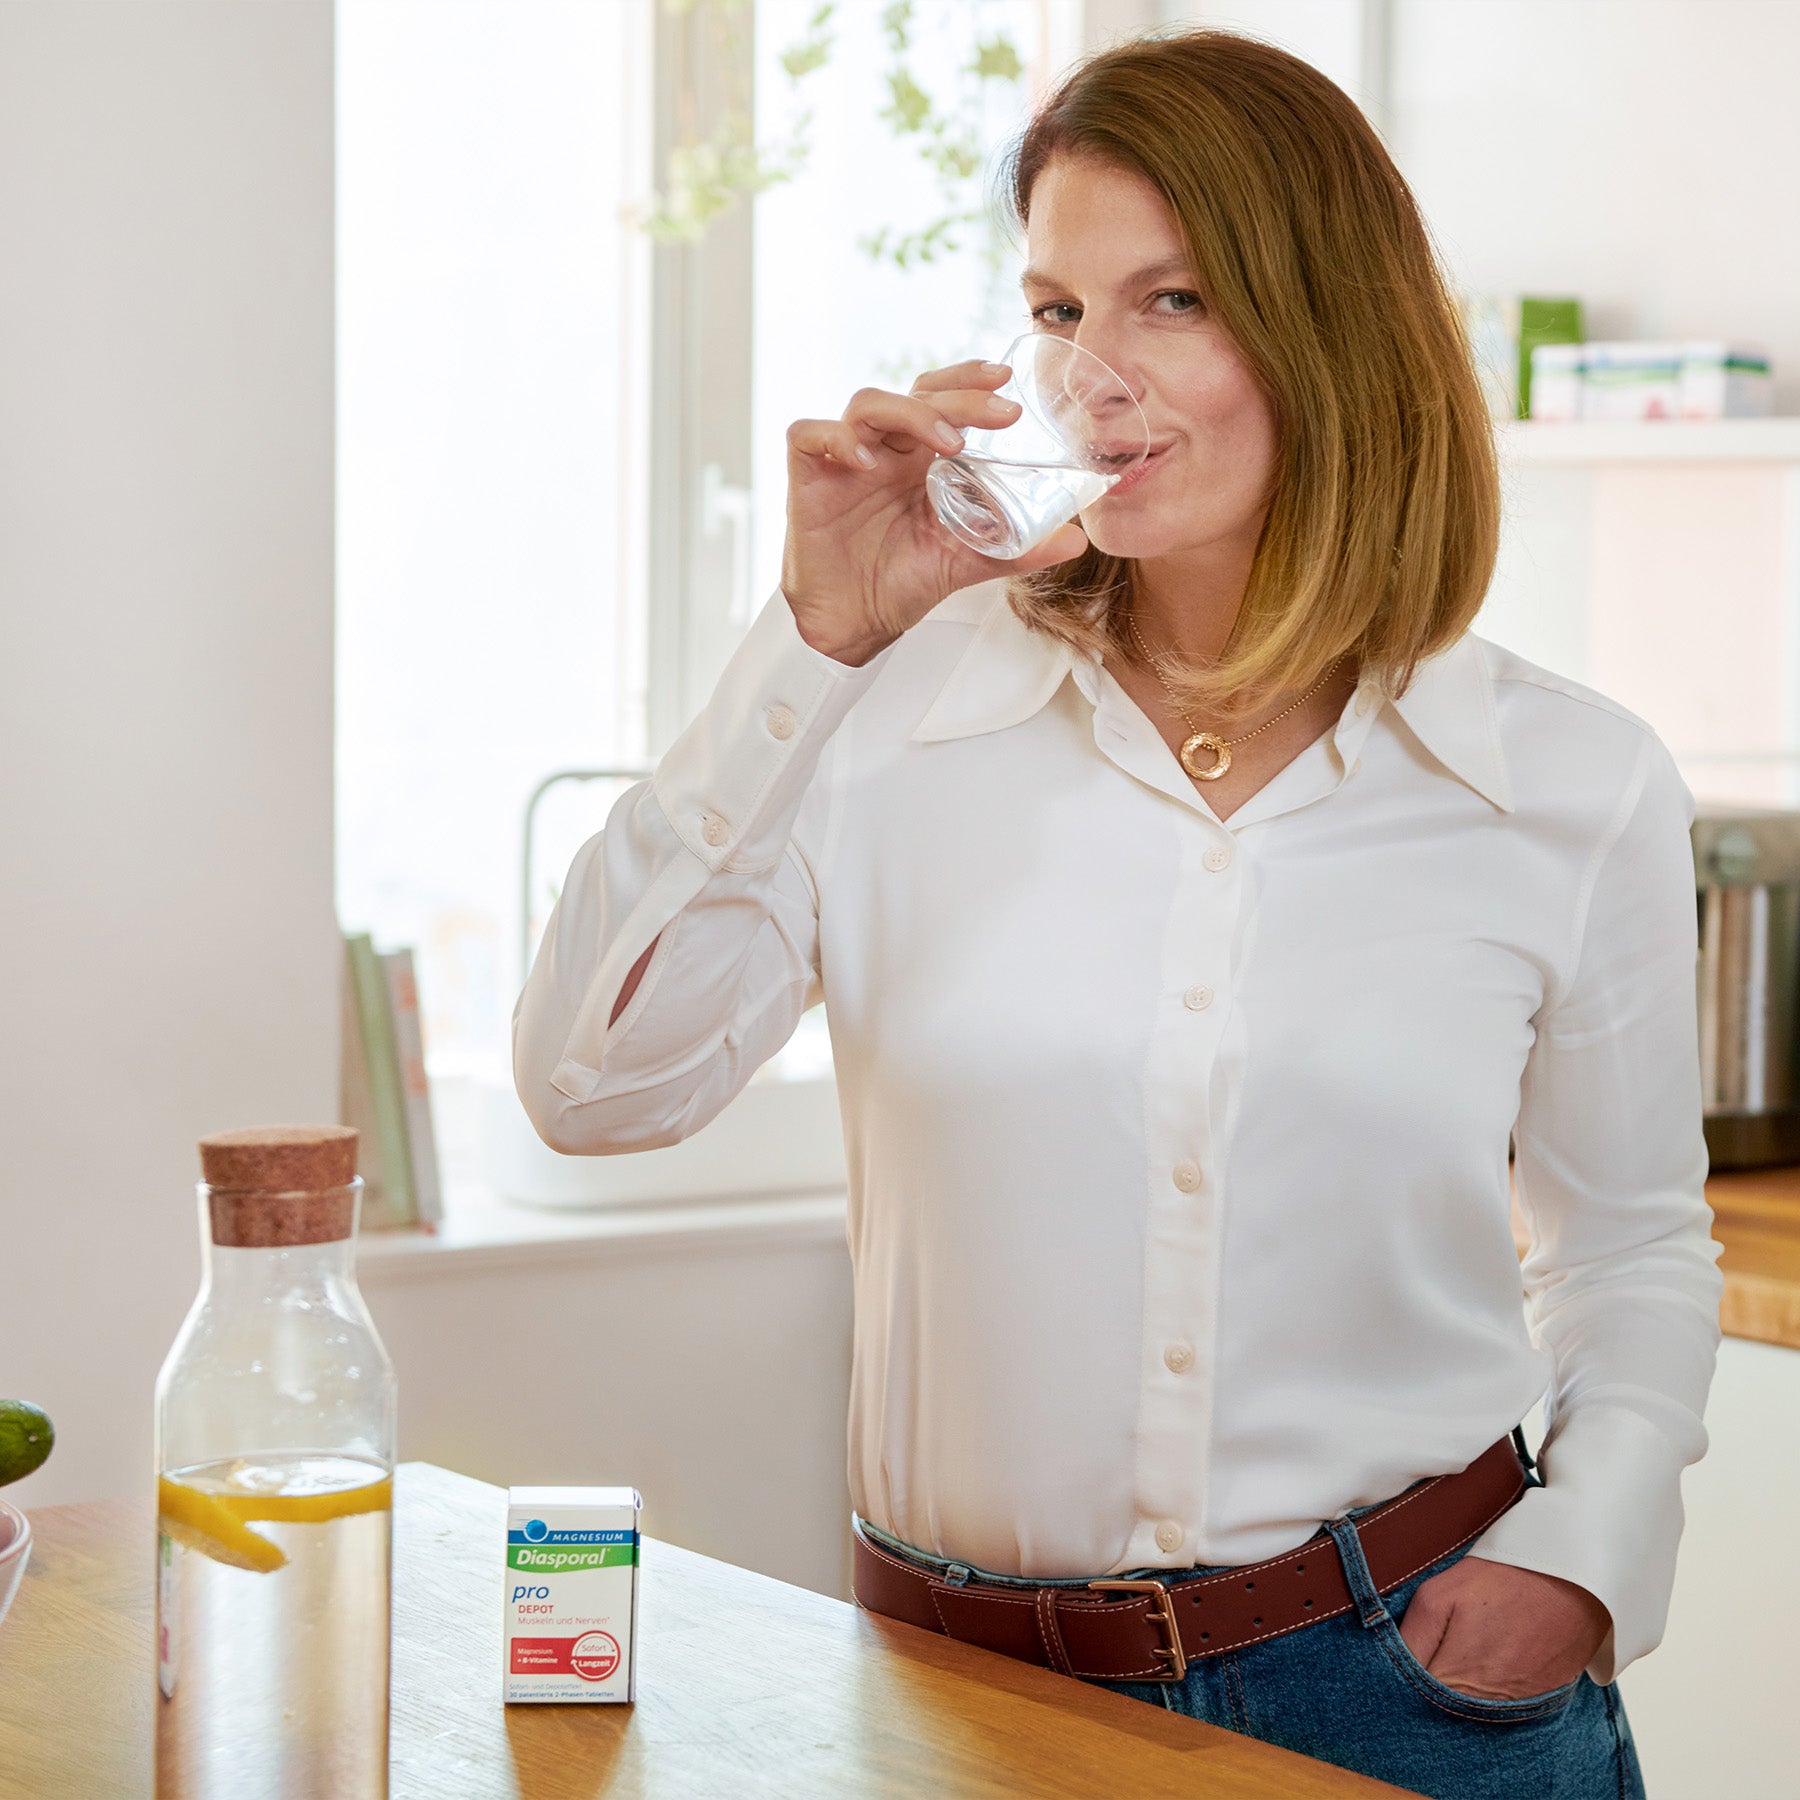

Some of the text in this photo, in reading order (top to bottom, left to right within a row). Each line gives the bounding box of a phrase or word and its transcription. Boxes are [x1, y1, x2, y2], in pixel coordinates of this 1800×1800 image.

[552, 1533, 623, 1542] MAGNESIUM
[512, 1586, 549, 1603] pro
[518, 1604, 554, 1614] DEPOT
[582, 1644, 607, 1652] Sofort
[578, 1659, 611, 1668] Langzeit
